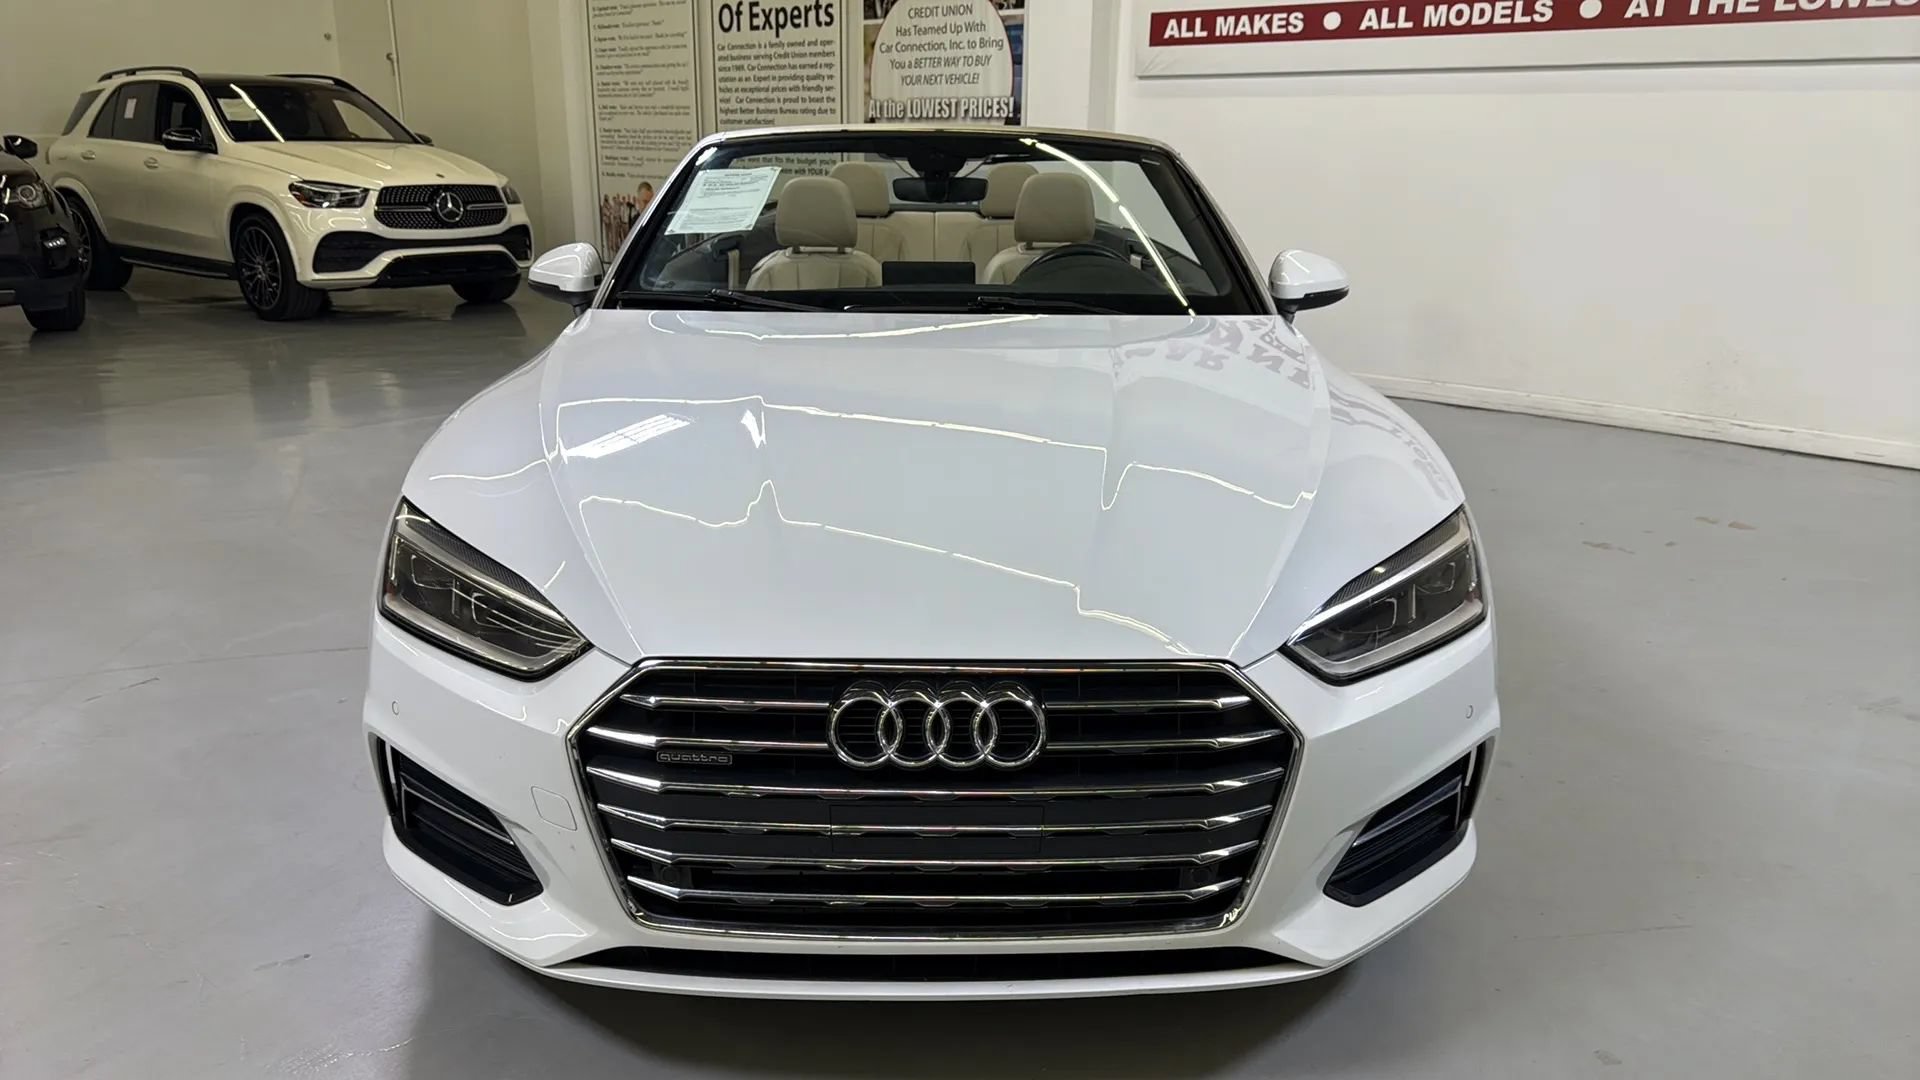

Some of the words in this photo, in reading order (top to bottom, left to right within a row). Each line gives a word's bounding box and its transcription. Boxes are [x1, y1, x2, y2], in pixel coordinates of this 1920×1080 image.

[718, 1, 743, 33] Of
[749, 0, 835, 38] Experts
[908, 6, 939, 19] CREDIT
[941, 4, 973, 17] UNION
[1164, 19, 1208, 39] ALL
[1215, 12, 1305, 36] MAKES
[1359, 8, 1414, 31] ALL
[1423, 0, 1554, 29] MODELS
[896, 26, 911, 36] Has
[914, 24, 947, 36] Teamed
[950, 23, 963, 36] Up
[965, 21, 986, 33] With
[880, 43, 893, 54] Car
[895, 41, 948, 52] Connection,
[949, 39, 965, 50] Inc.
[968, 40, 977, 49] to
[979, 37, 1004, 51] Bring
[890, 59, 905, 70] You
[908, 61, 912, 69] a
[914, 56, 942, 69] BETTER
[944, 57, 961, 68] WAY
[962, 56, 974, 67] TO
[975, 55, 992, 66] BUY
[900, 75, 923, 86] YOUR
[924, 74, 943, 85] NEXT
[945, 73, 980, 85] VEHICLE!
[869, 99, 880, 118] At
[883, 99, 904, 118] the
[907, 98, 957, 118] LOWEST
[960, 97, 1014, 118] PRICES!
[659, 753, 728, 763] quattro
